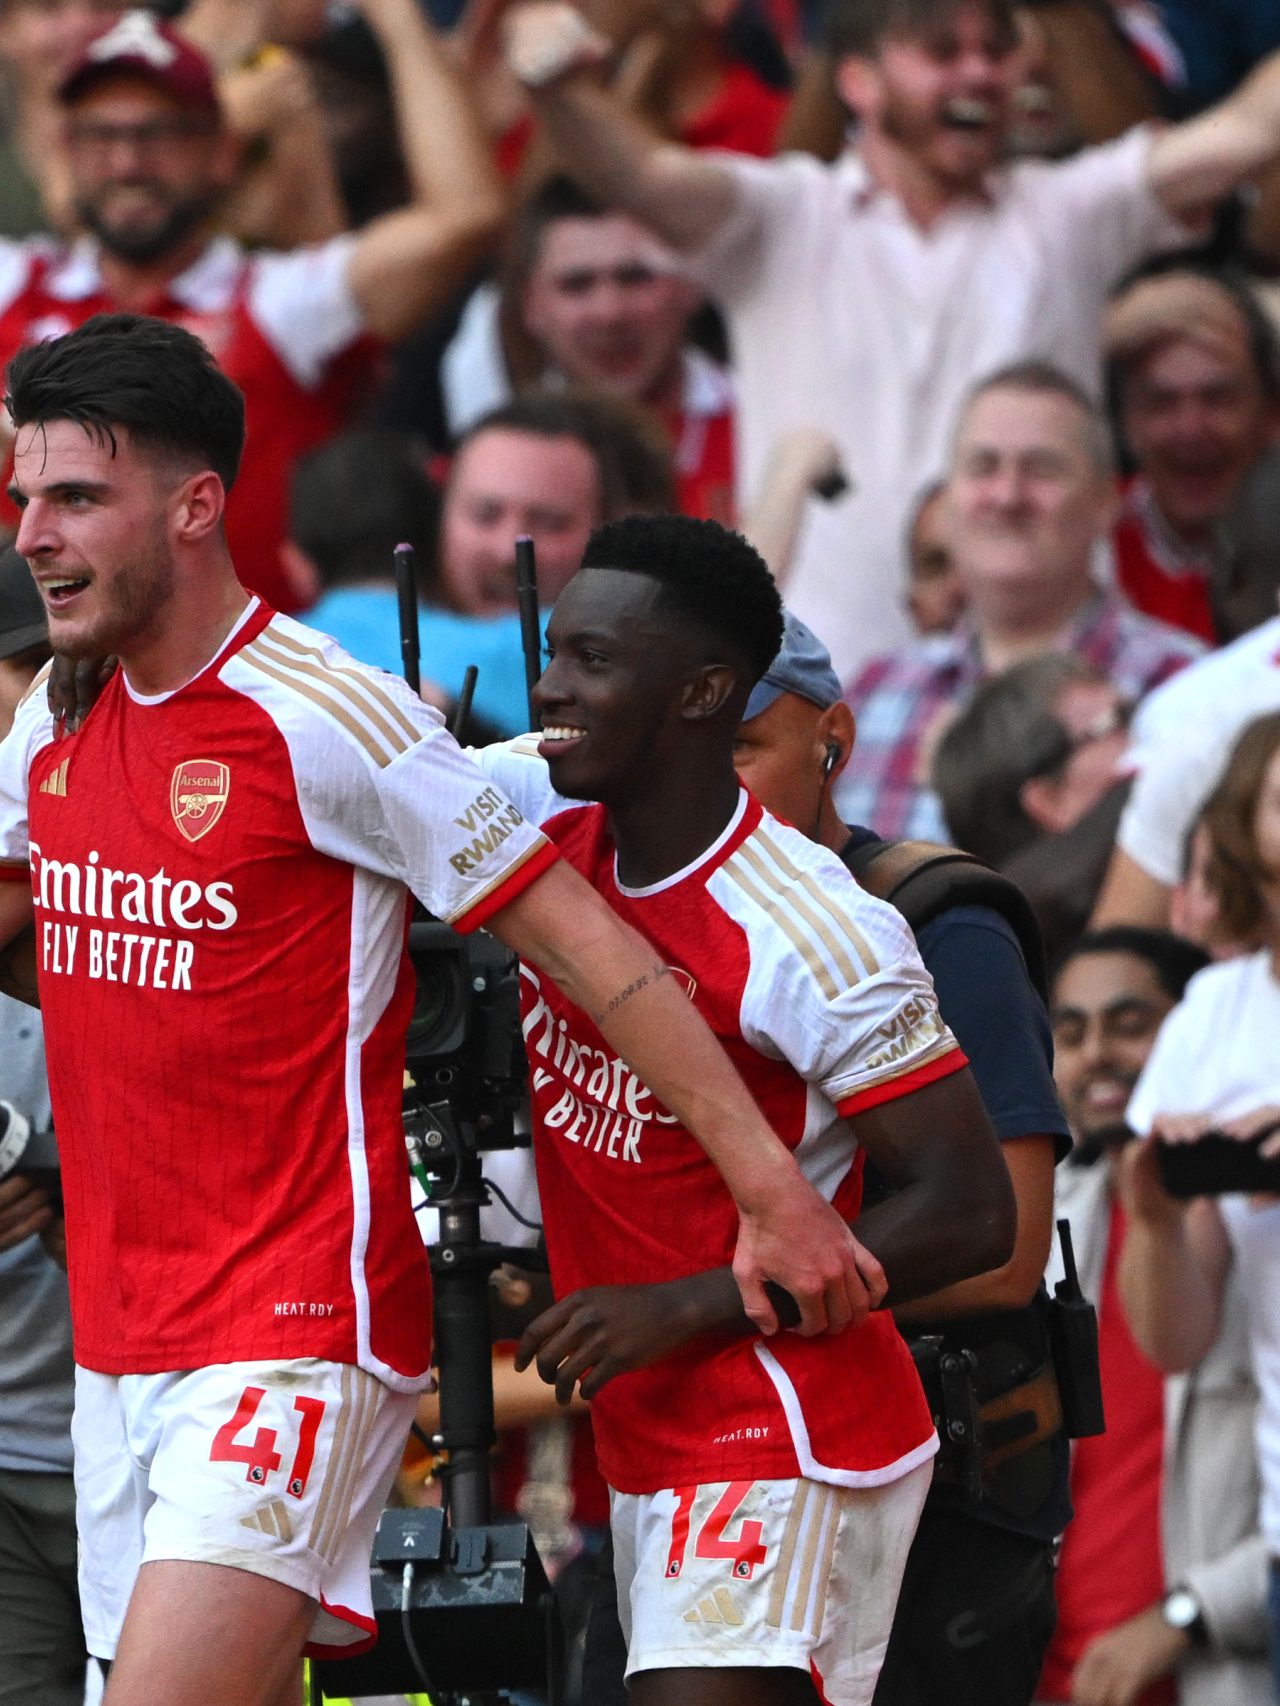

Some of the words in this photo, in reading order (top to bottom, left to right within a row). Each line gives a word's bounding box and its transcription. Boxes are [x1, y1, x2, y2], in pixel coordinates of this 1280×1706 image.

[180, 774, 221, 788] Arsenal
[453, 786, 503, 832] VISIT
[449, 804, 524, 876] RWAND
[43, 921, 78, 975] FLY
[89, 928, 195, 991] BETTER
[544, 1087, 642, 1164] BETTER
[274, 1302, 334, 1317] HEAT.RDY
[208, 1385, 327, 1500] 41
[713, 1426, 769, 1444] HEAT.RDY
[664, 1480, 768, 1580] 14
